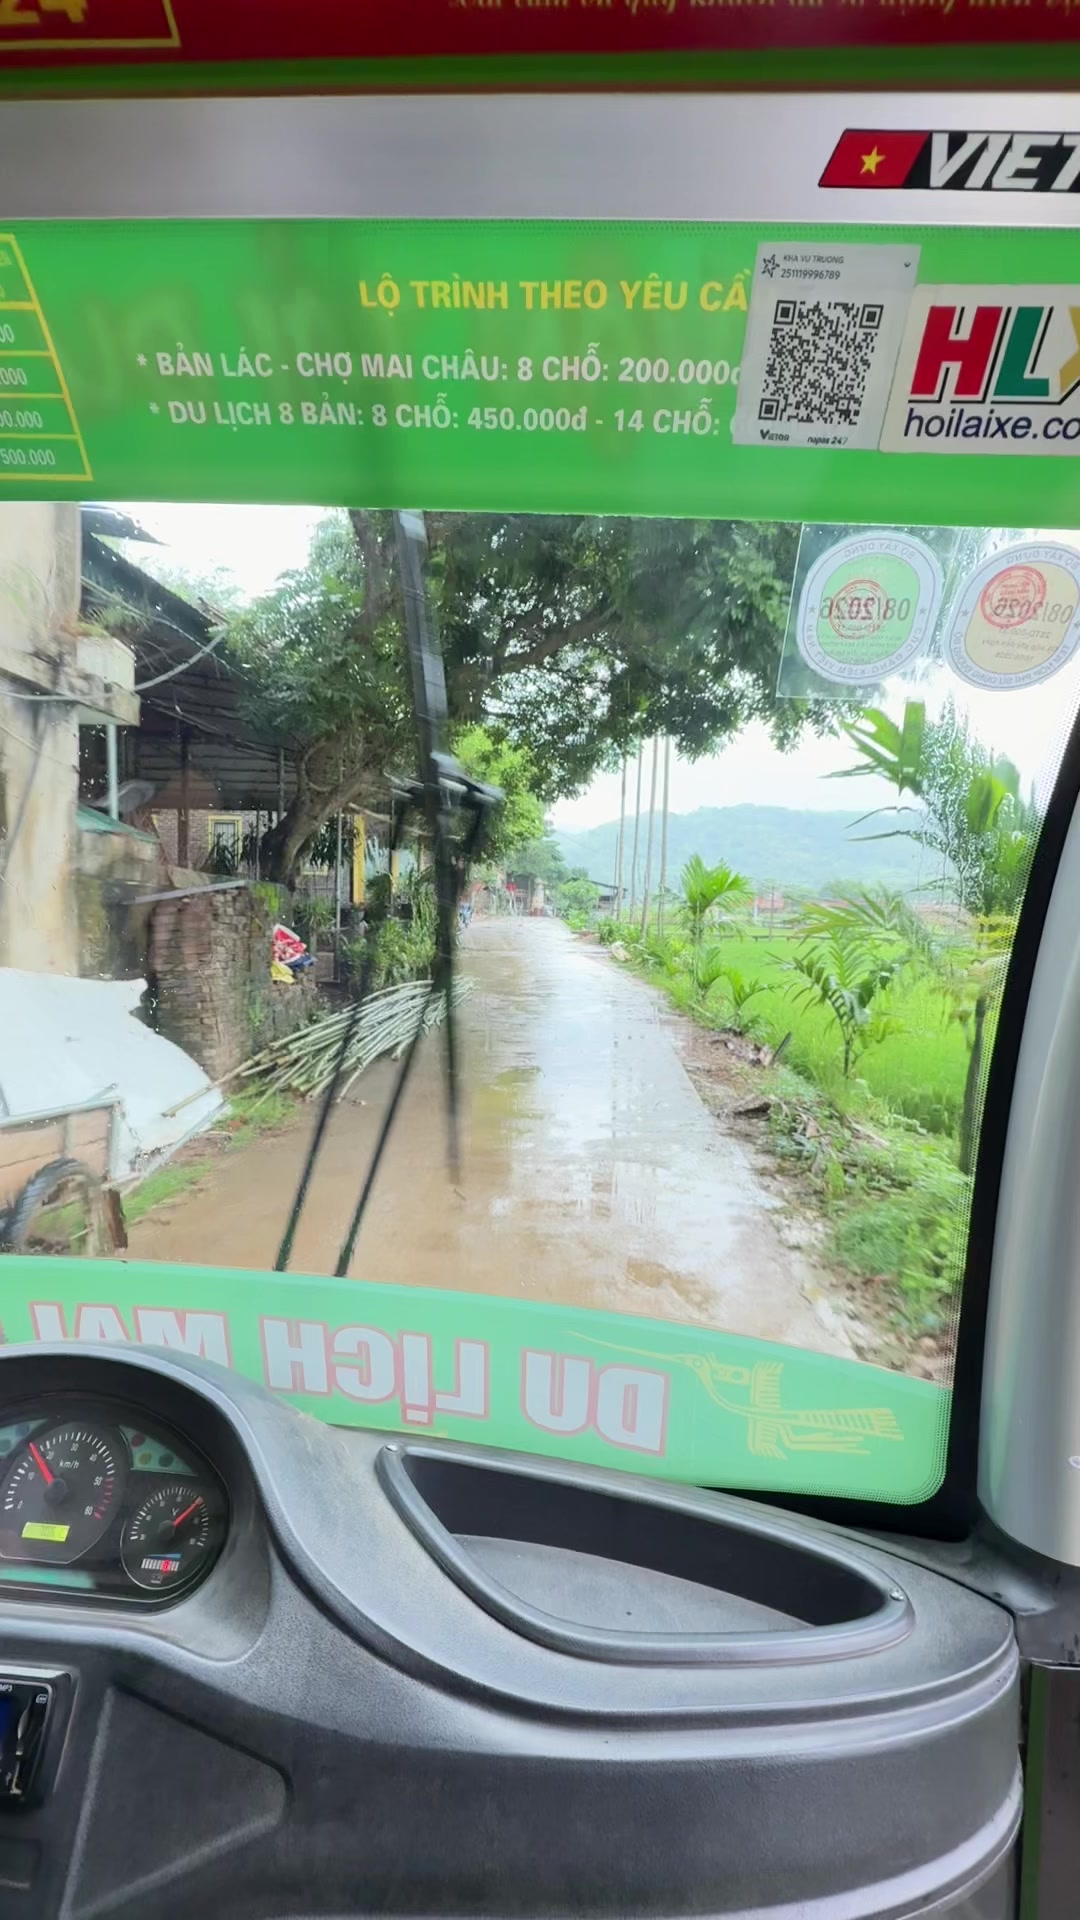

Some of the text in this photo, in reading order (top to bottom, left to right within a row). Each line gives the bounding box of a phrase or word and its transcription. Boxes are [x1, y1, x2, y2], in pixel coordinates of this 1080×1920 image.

[359, 268, 753, 317] LỘ TRÌNH THEO YÊU CẦ
[157, 342, 214, 378] BẢN
[220, 347, 273, 378] LÁC
[296, 351, 353, 384] CHỢ
[362, 353, 413, 380] MAI
[422, 349, 508, 382] CHÂU:
[517, 356, 533, 382] 8
[542, 342, 609, 382] CHỖ:
[170, 400, 207, 425] DU
[214, 402, 272, 431] LỊCH
[279, 403, 295, 425] 8
[302, 392, 365, 427] BẢN:
[372, 403, 388, 427] 8
[396, 392, 459, 430] CHỖ:
[468, 406, 588, 432] 450.000đ
[614, 408, 645, 433] 14
[653, 398, 720, 436] CHỖ:
[59, 1460, 80, 1470] km/h
